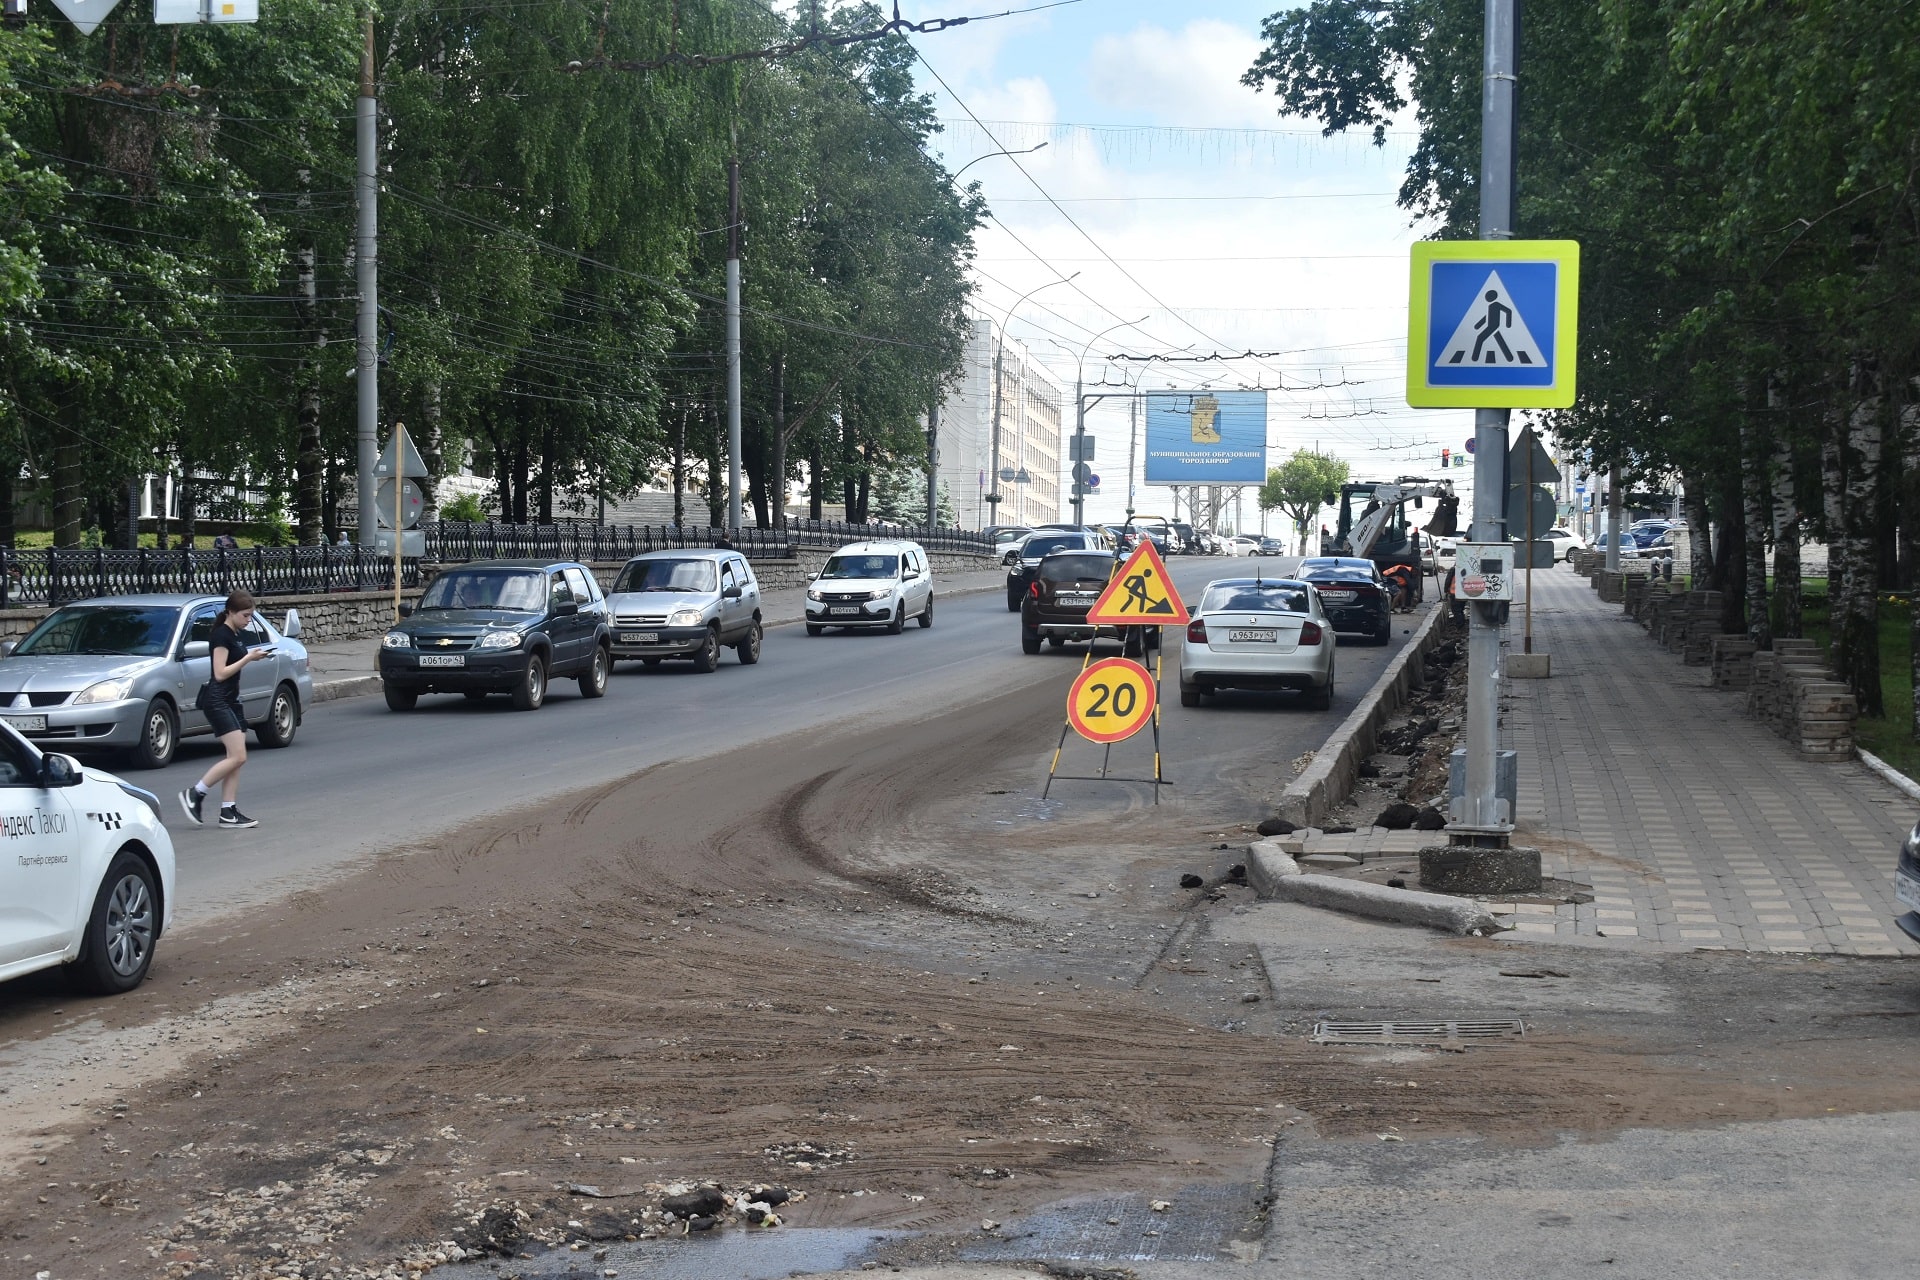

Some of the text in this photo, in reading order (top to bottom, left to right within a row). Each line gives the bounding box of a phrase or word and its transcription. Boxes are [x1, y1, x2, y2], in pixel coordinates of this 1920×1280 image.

[1232, 631, 1264, 640] А963РУ
[422, 656, 452, 665] А061ОР
[1085, 683, 1136, 717] 20
[34, 807, 68, 834] Такси
[18, 854, 68, 867] Партнёр сервиса
